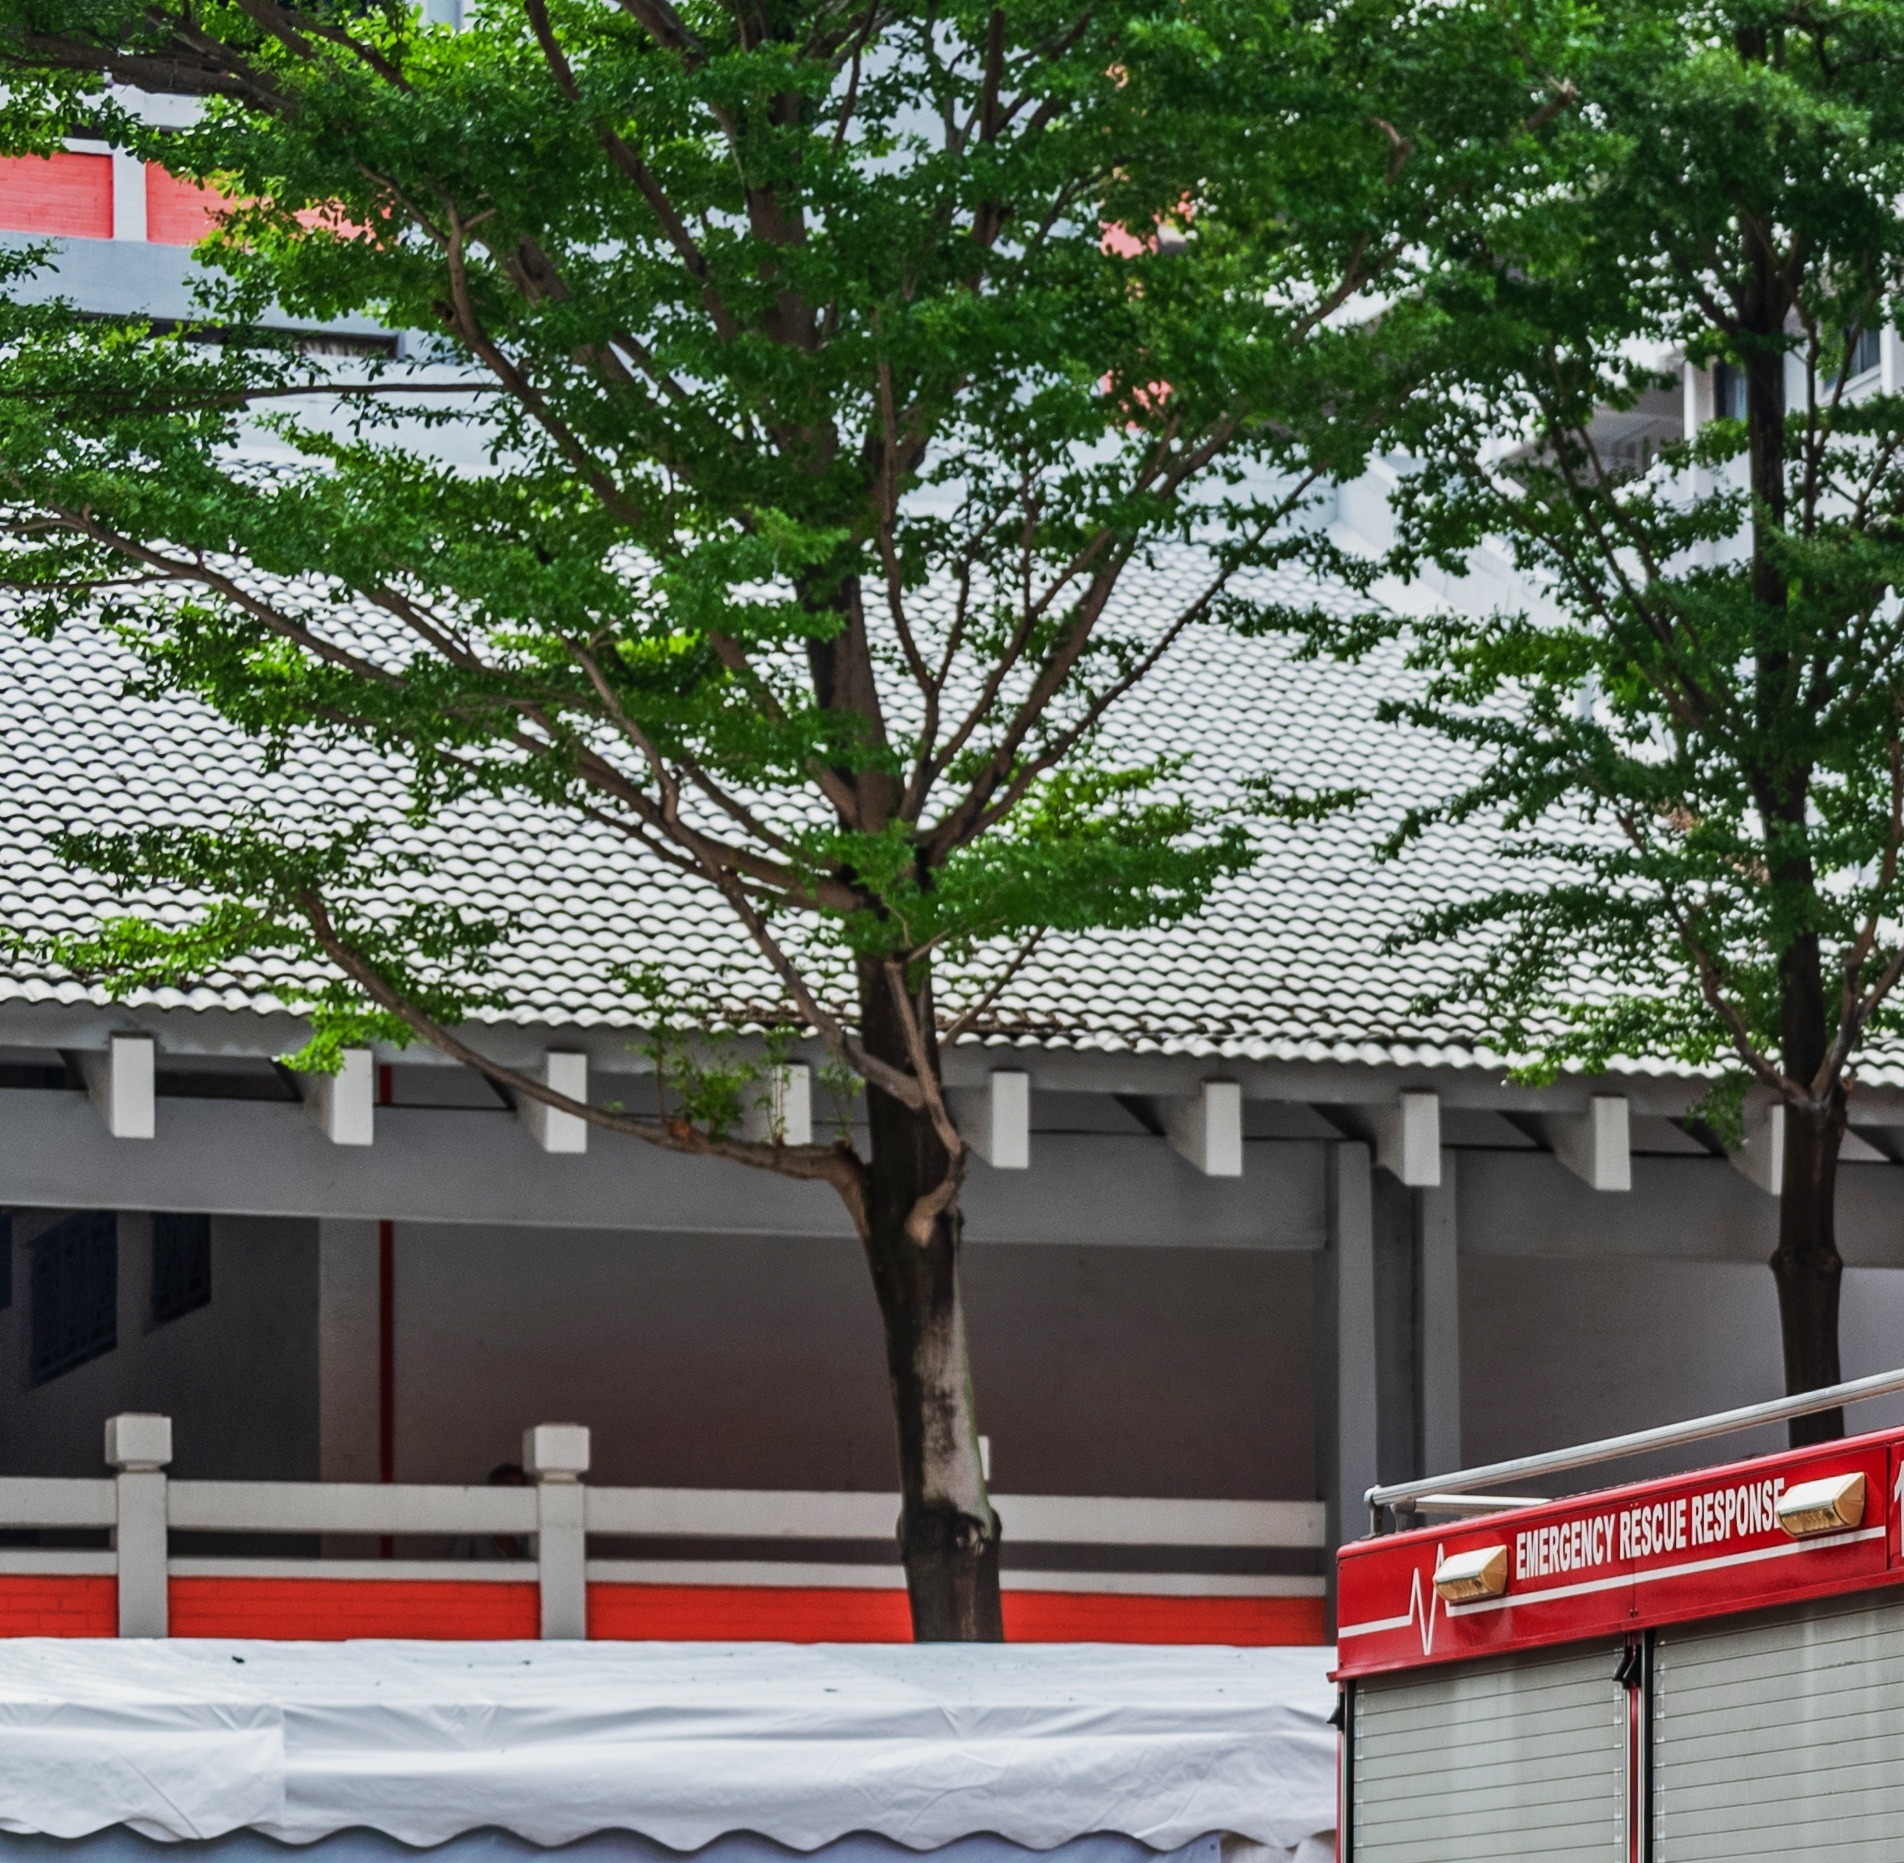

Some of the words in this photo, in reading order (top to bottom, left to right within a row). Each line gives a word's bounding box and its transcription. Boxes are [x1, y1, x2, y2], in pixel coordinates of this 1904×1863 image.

[1516, 1513, 1616, 1581] EMERGENCY
[1619, 1498, 1687, 1560] RESCUE
[1691, 1476, 1786, 1546] RESPONSE
